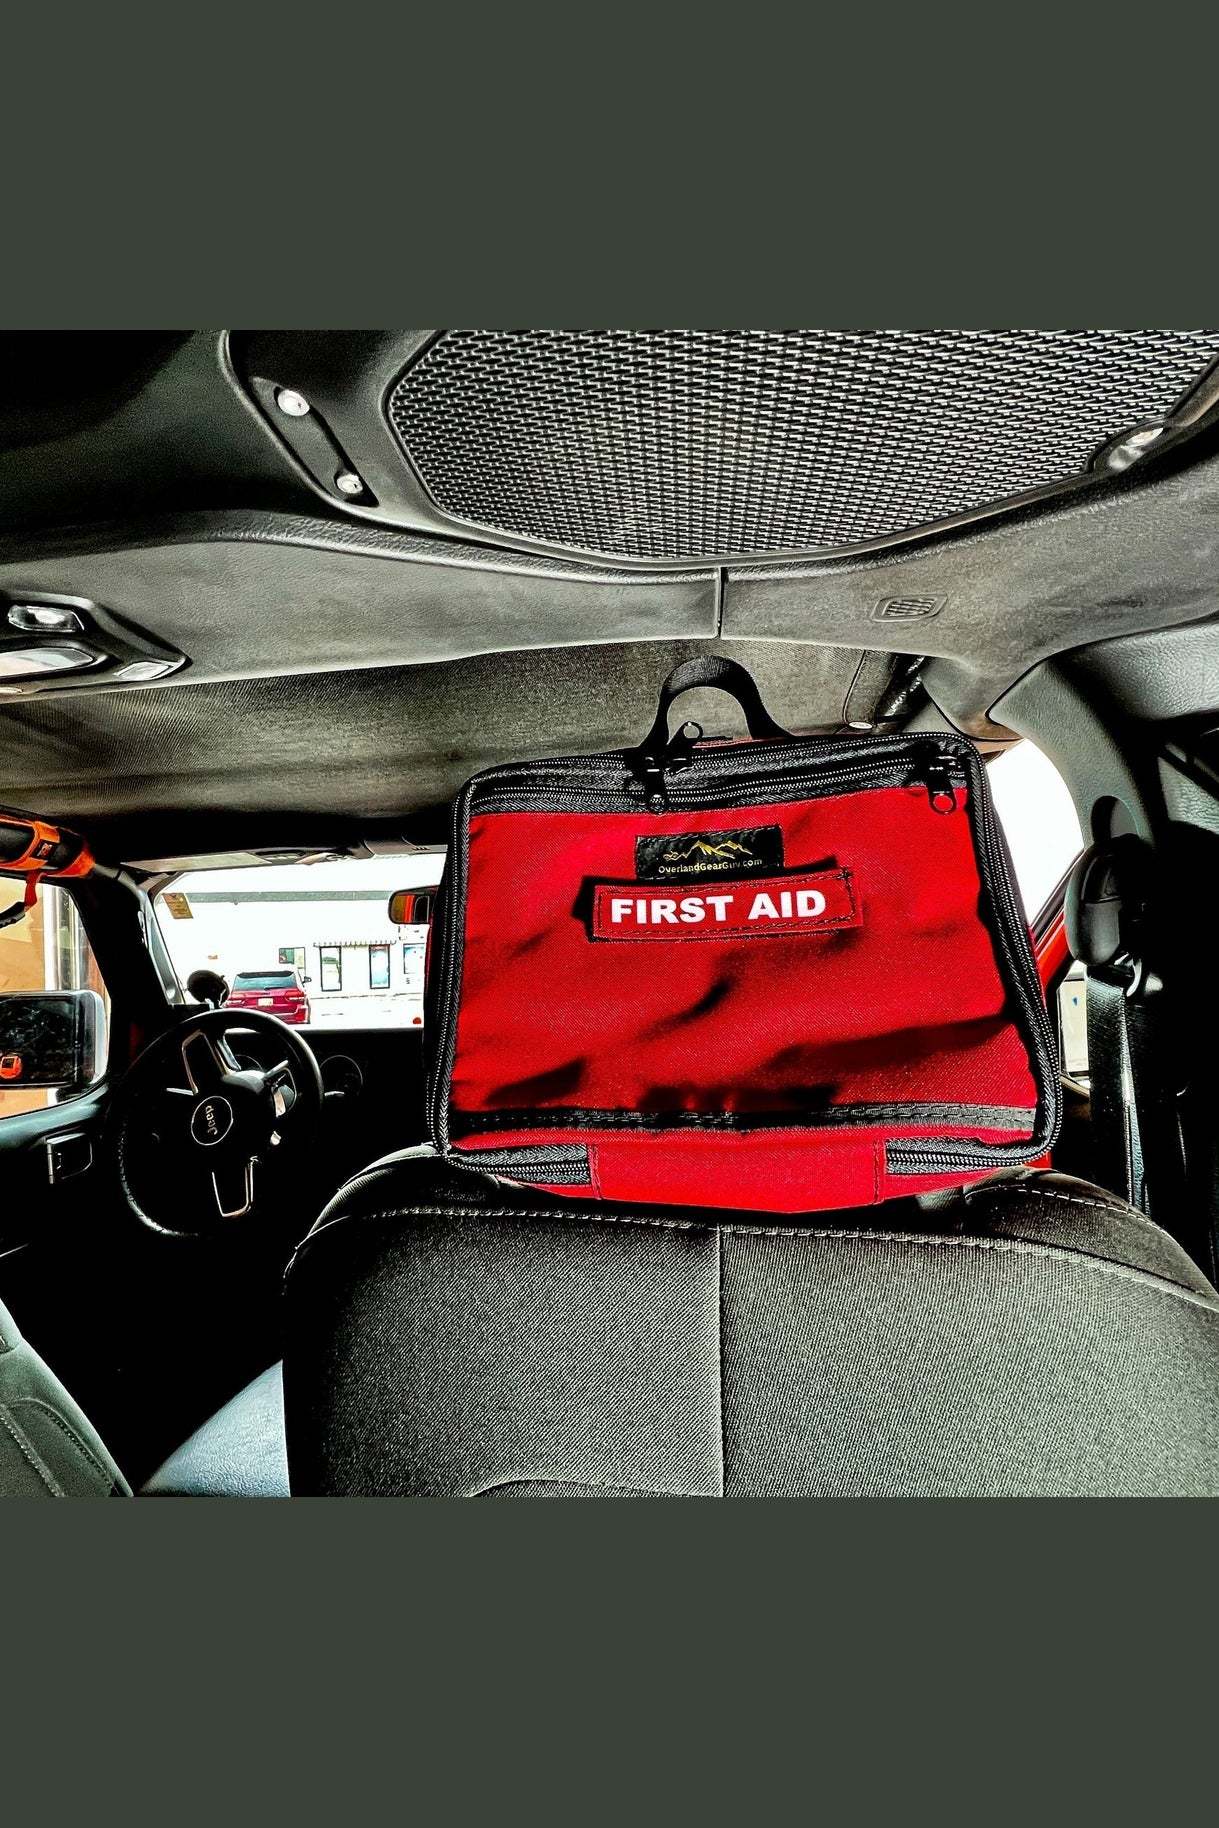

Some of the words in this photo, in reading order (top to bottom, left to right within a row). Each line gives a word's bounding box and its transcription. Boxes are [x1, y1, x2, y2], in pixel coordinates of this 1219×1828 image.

[611, 896, 734, 925] FIRST
[748, 890, 827, 920] AID
[206, 1105, 218, 1136] Jeep
